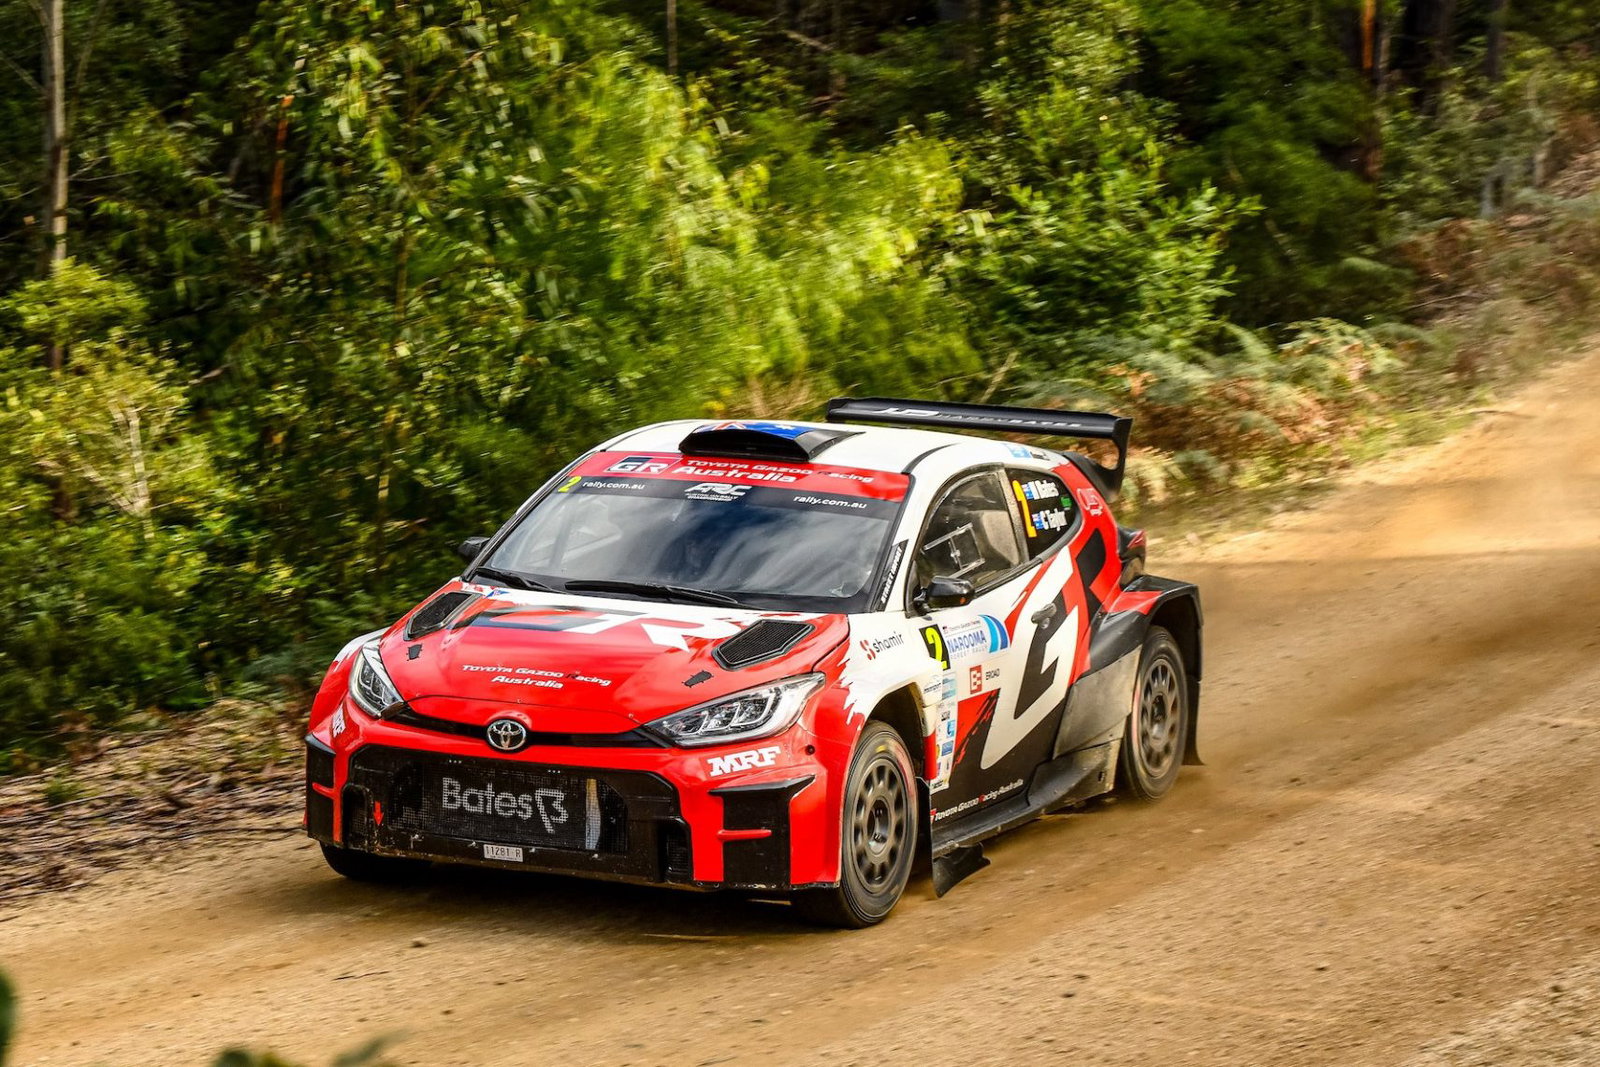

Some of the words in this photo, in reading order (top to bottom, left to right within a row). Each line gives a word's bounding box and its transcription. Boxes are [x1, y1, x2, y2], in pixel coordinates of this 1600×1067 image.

[607, 457, 670, 475] GR
[672, 465, 797, 484] Australia
[687, 459, 750, 470] TOYOTA
[817, 470, 875, 484] Racing
[557, 475, 582, 493] 2
[582, 479, 646, 491] rally.com.au
[792, 494, 868, 510] rally.com.au
[872, 630, 905, 653] shamir
[925, 627, 948, 670] 2
[946, 630, 987, 653] NAROOMA
[462, 663, 513, 675] TOYOTA
[516, 667, 563, 679] GAZOO
[566, 671, 612, 687] Racing
[491, 674, 564, 690] Australia
[707, 745, 782, 777] MRF
[442, 776, 534, 820] Bates
